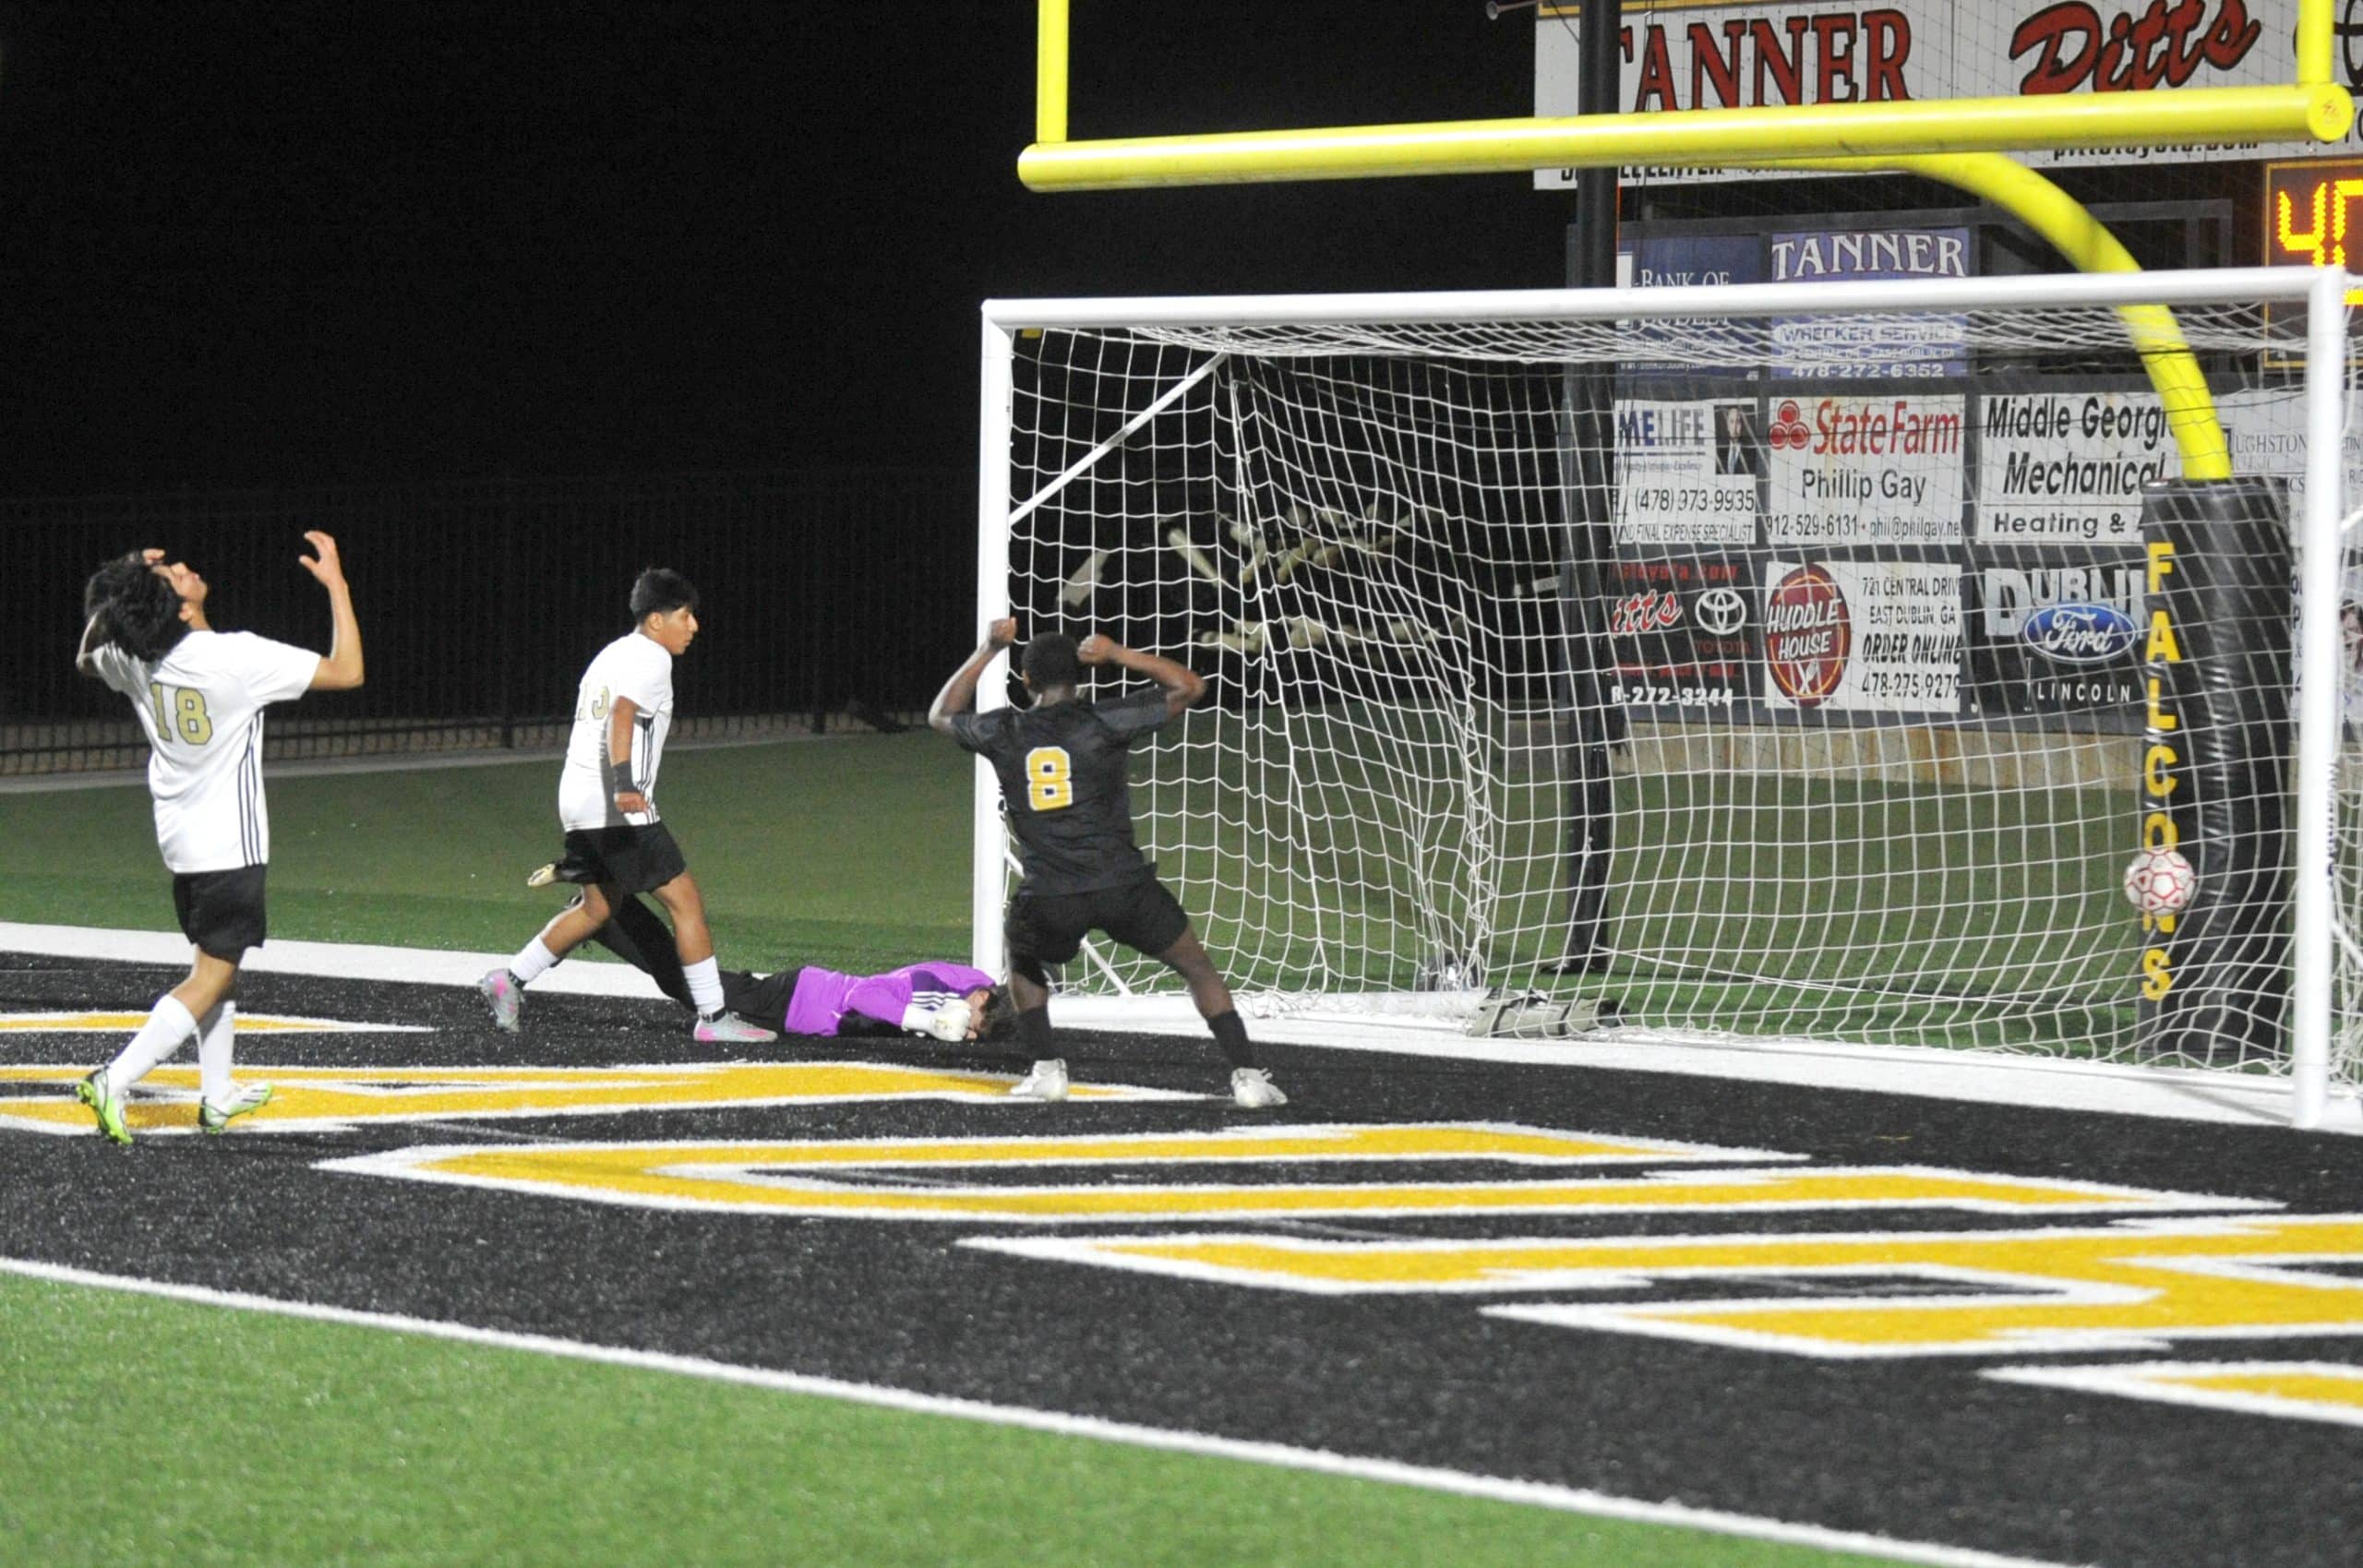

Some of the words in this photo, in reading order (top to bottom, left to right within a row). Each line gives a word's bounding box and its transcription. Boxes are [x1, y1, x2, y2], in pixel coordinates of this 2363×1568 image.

[1620, 8, 1915, 113] ANNER
[1771, 232, 1968, 281] TANNER
[1792, 363, 1945, 378] 478-272-6352
[1813, 399, 1887, 455] State
[1889, 401, 1960, 455] Farm
[1985, 397, 2071, 438] Middle
[2081, 397, 2176, 451] Georgi
[1802, 468, 1874, 506] Phillip
[1880, 468, 1927, 507] Gay
[2002, 450, 2166, 496] Mechanical
[1635, 487, 1674, 512] (478)
[1766, 514, 1858, 536] 912-529-6131
[1994, 512, 2099, 539] Heating
[2109, 513, 2126, 534] &
[1862, 577, 1881, 596] 721
[1766, 599, 1842, 634] HUDDLE
[1869, 604, 1893, 625] EAST
[1940, 605, 1956, 625] GA
[2045, 610, 2114, 652] Ford
[1778, 630, 1833, 661] HOUSE
[1862, 633, 1909, 664] ORDER
[2037, 682, 2131, 702] LINCOLN
[148, 683, 214, 747] 18
[1025, 745, 1074, 812] 8
